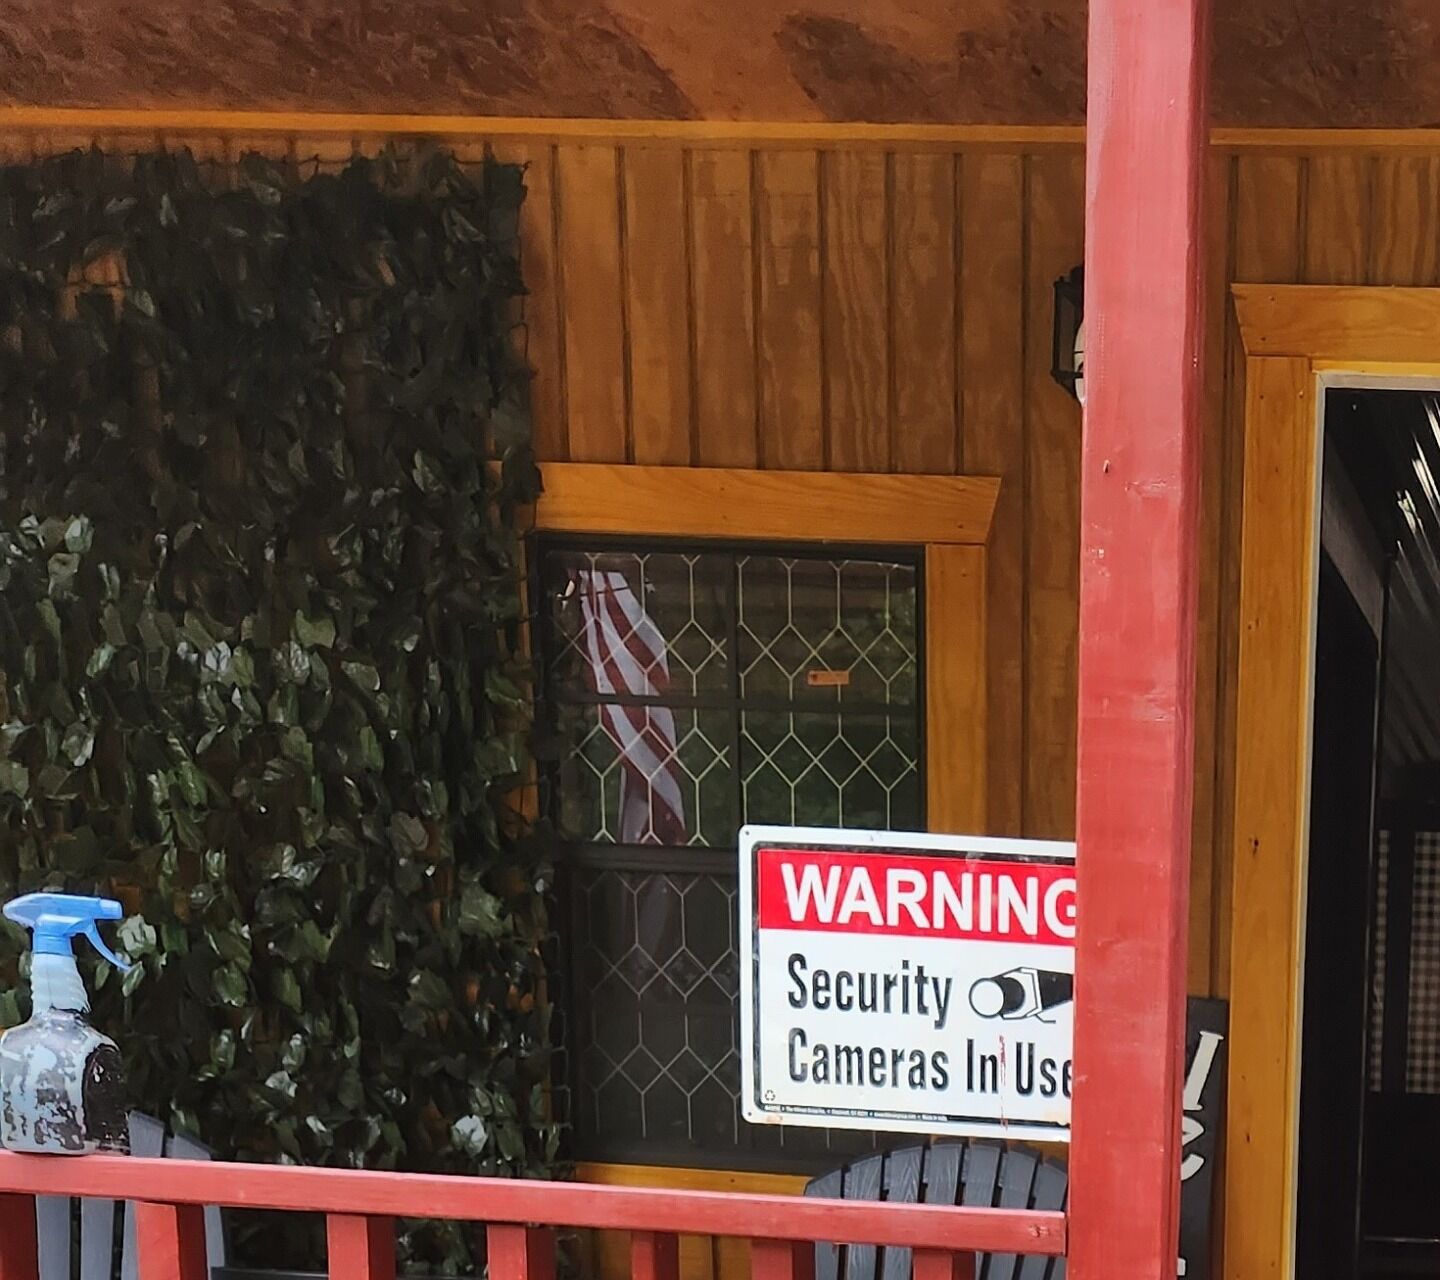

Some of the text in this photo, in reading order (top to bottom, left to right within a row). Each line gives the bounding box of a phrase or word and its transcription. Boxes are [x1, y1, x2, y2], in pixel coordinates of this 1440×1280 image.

[781, 863, 1075, 938] WARNING
[787, 952, 953, 1029] Security
[788, 1027, 949, 1091] Cameras
[967, 1038, 999, 1095] In
